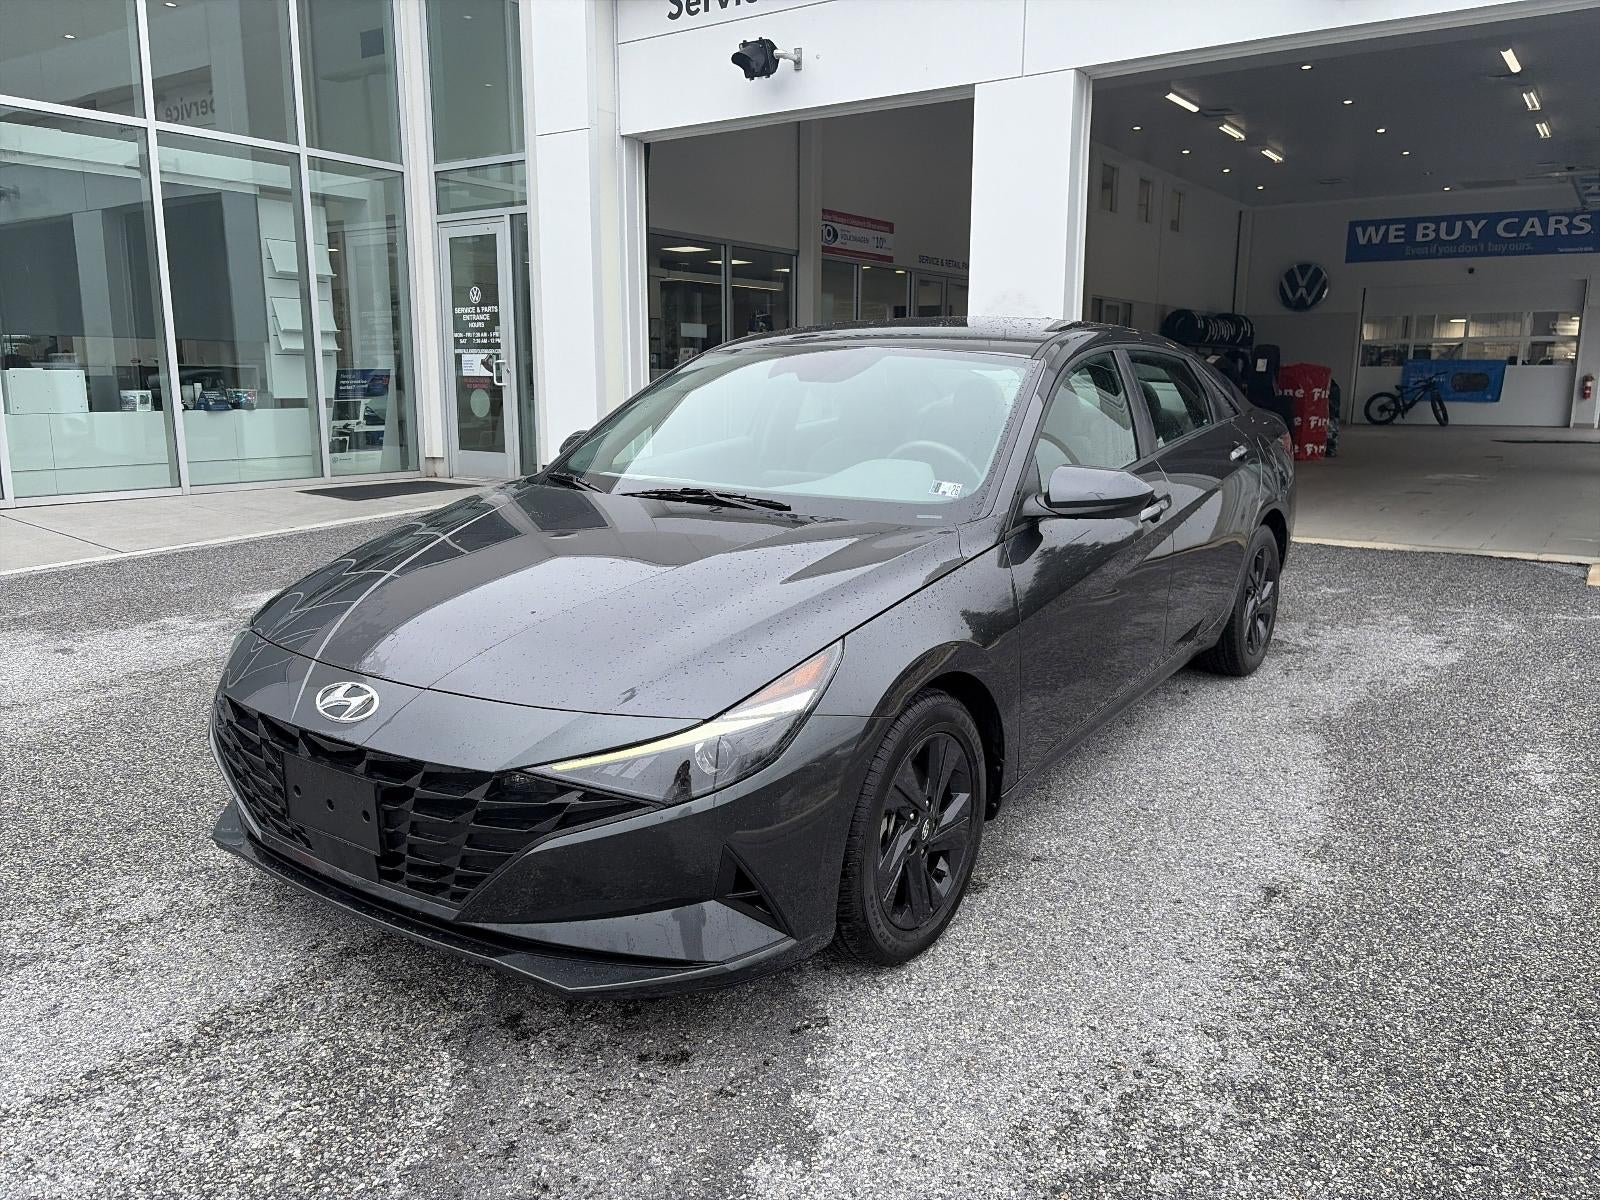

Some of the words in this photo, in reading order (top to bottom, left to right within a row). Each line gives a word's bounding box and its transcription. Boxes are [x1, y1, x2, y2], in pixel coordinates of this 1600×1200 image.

[1355, 224, 1406, 246] WE
[1415, 219, 1488, 243] BUY
[1496, 214, 1592, 238] CARS
[1405, 245, 1428, 256] Even
[1437, 245, 1457, 256] you
[1458, 242, 1484, 253] don't
[1488, 242, 1506, 254] buy
[918, 255, 940, 266] SERVICE
[944, 259, 961, 269] RETAIL
